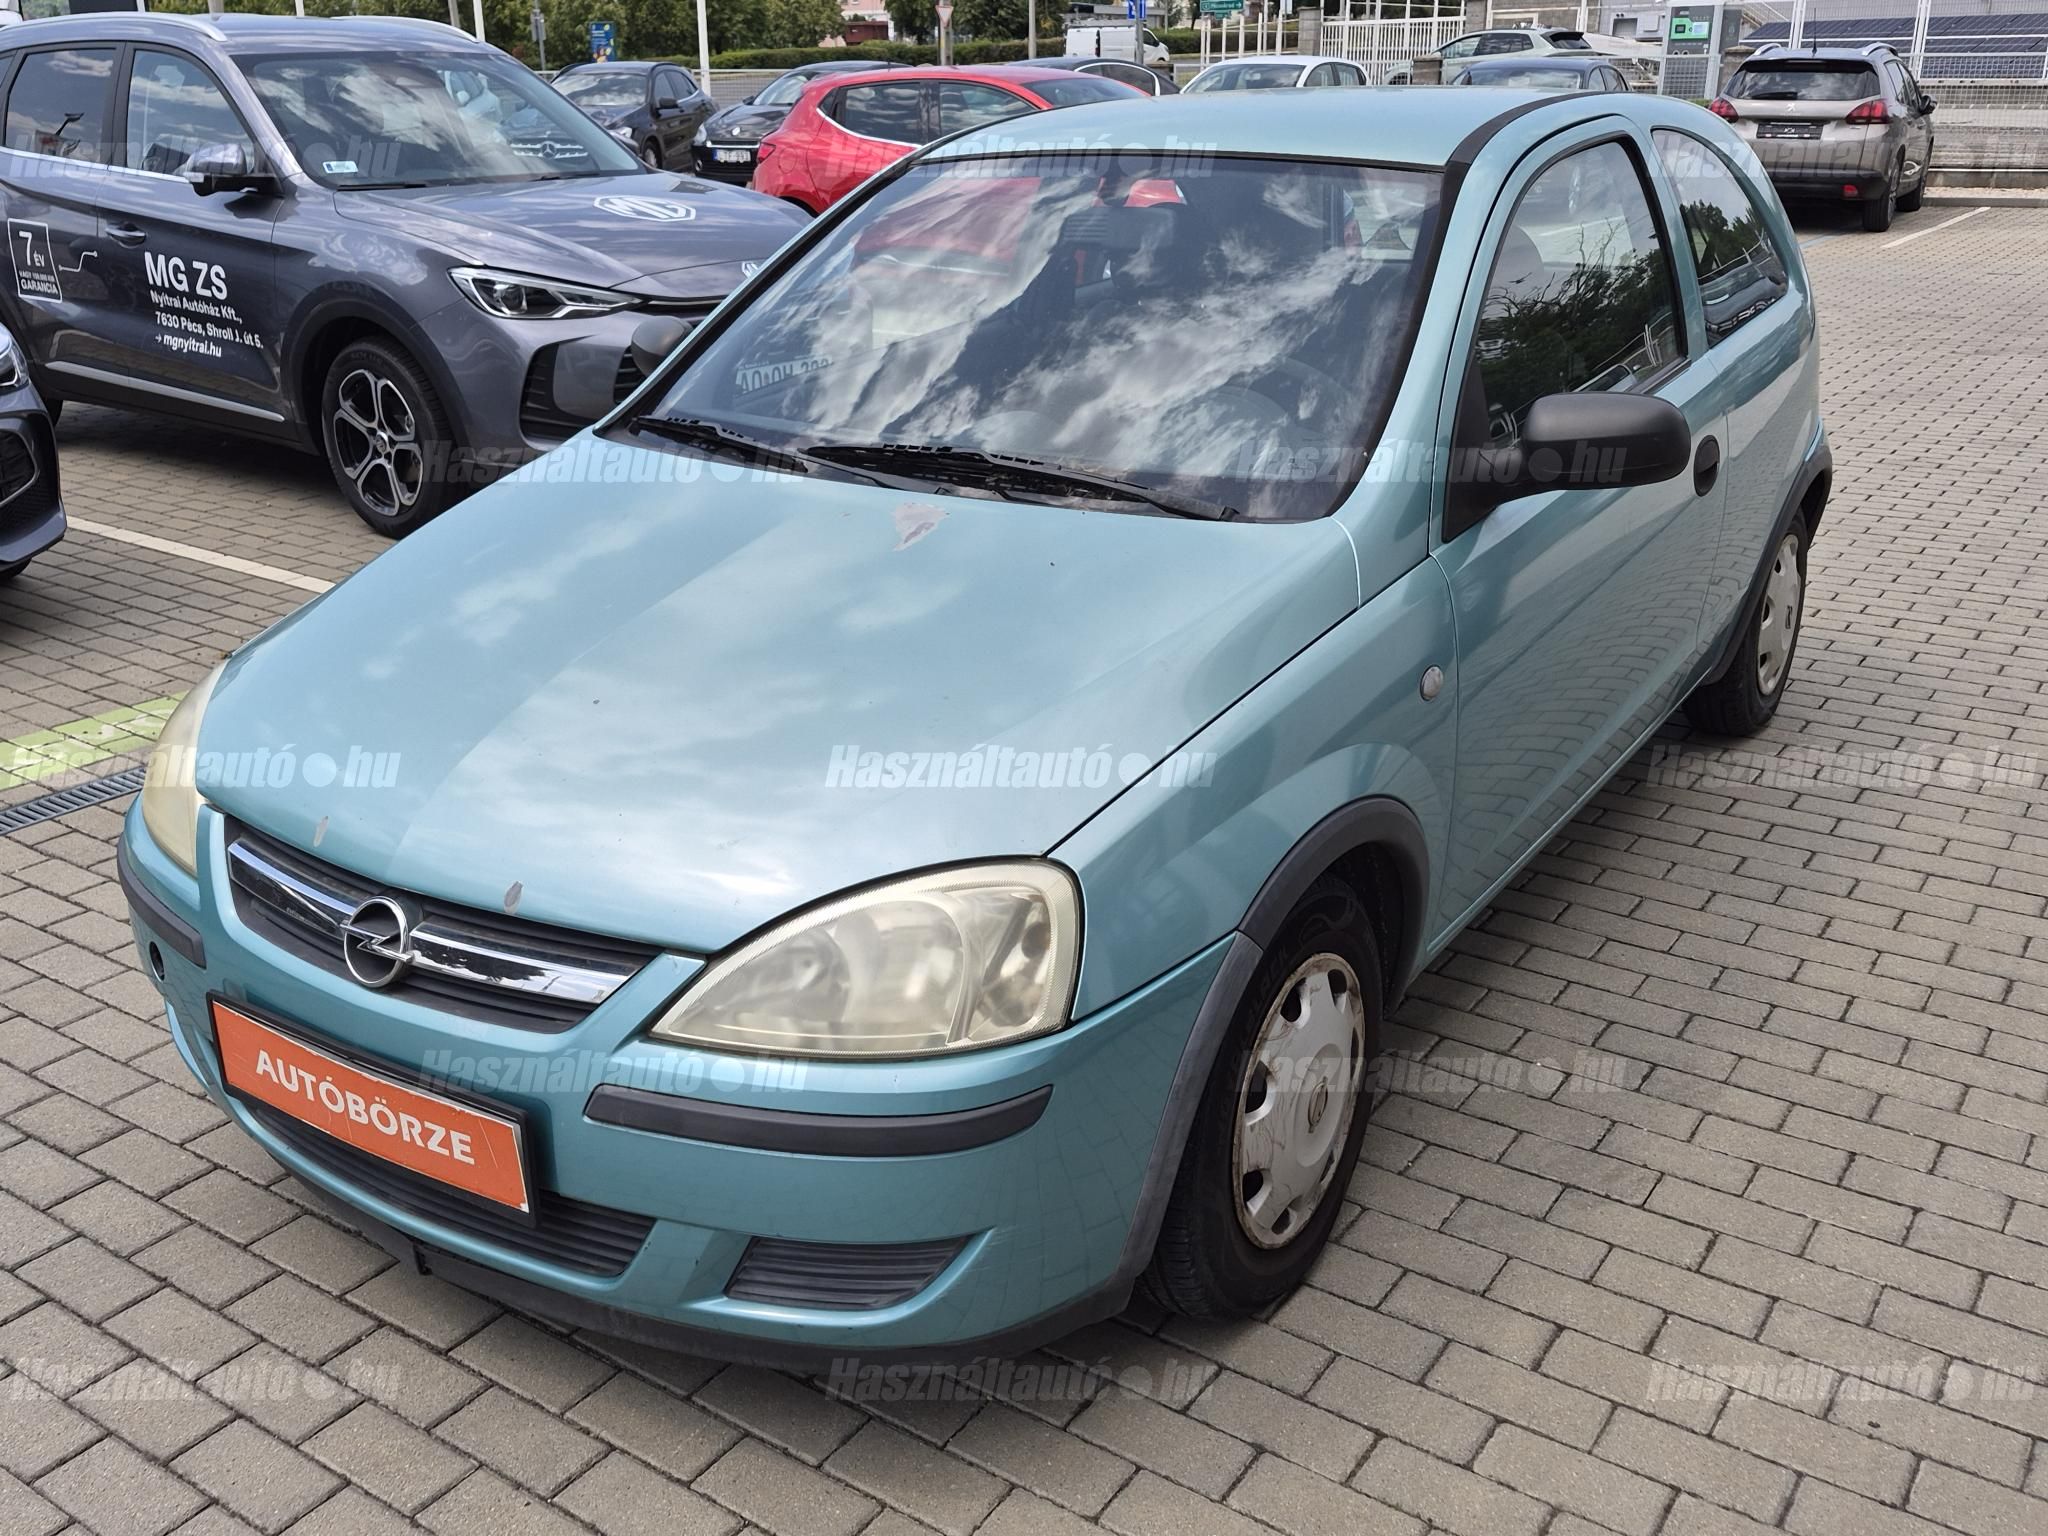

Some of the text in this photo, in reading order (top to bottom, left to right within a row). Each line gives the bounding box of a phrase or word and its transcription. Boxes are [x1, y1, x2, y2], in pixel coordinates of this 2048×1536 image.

[19, 230, 45, 267] 7 ÉV
[20, 278, 58, 295] GARANCIA
[144, 251, 228, 300] MG ZS
[182, 297, 221, 317] Autóház
[155, 311, 179, 329] 7630
[180, 317, 206, 337] Pécs,
[206, 322, 234, 341] Shroll
[163, 334, 222, 358] mgnyitrai.hu
[256, 1050, 476, 1166] AUTÓBÖRZE
